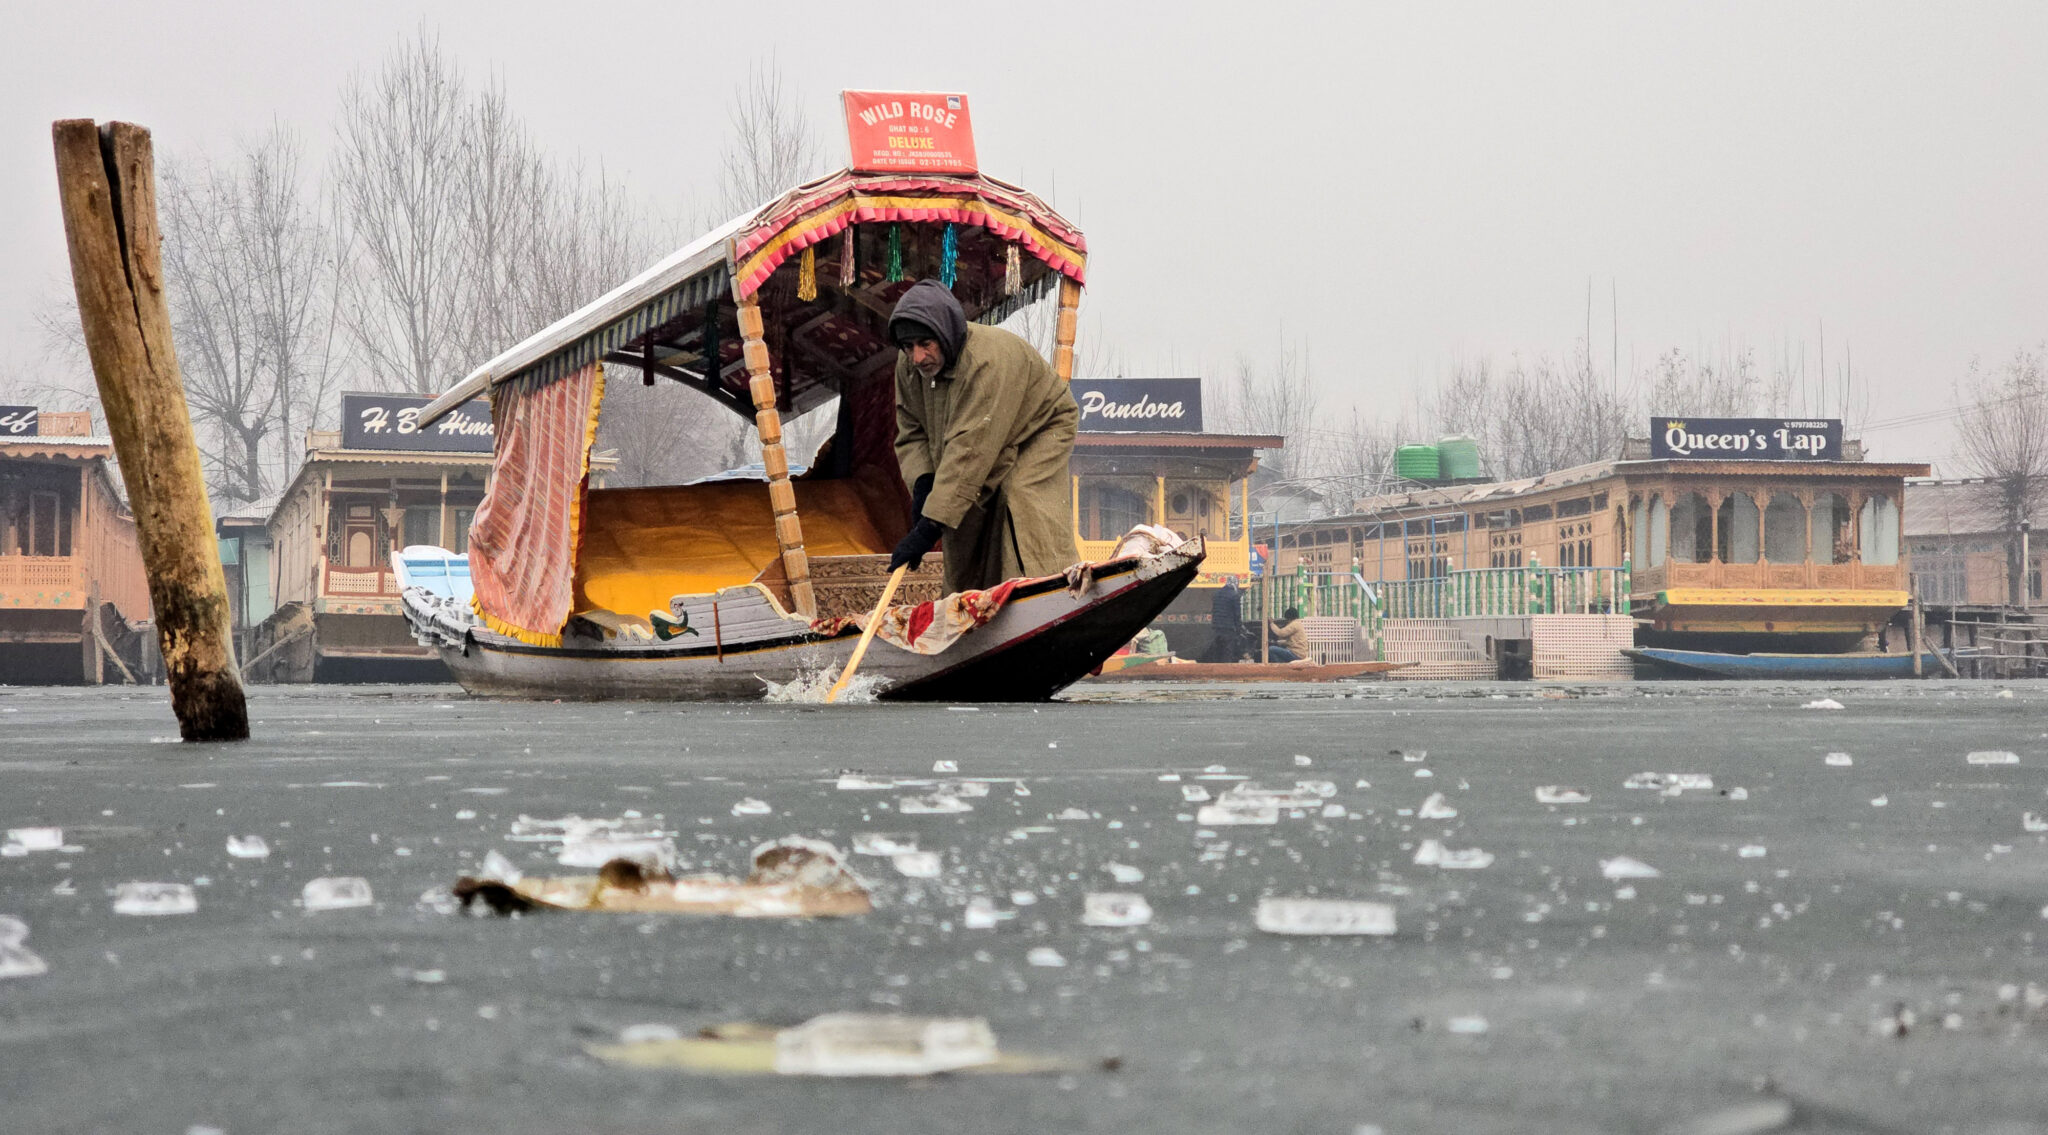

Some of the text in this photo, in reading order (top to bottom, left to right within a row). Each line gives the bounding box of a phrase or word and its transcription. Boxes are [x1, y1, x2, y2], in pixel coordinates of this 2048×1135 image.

[859, 101, 957, 129] WILD ROSE
[888, 136, 934, 149] DELUXE
[1081, 391, 1185, 419] Pandora
[1665, 427, 1827, 456] Queen's Lap
